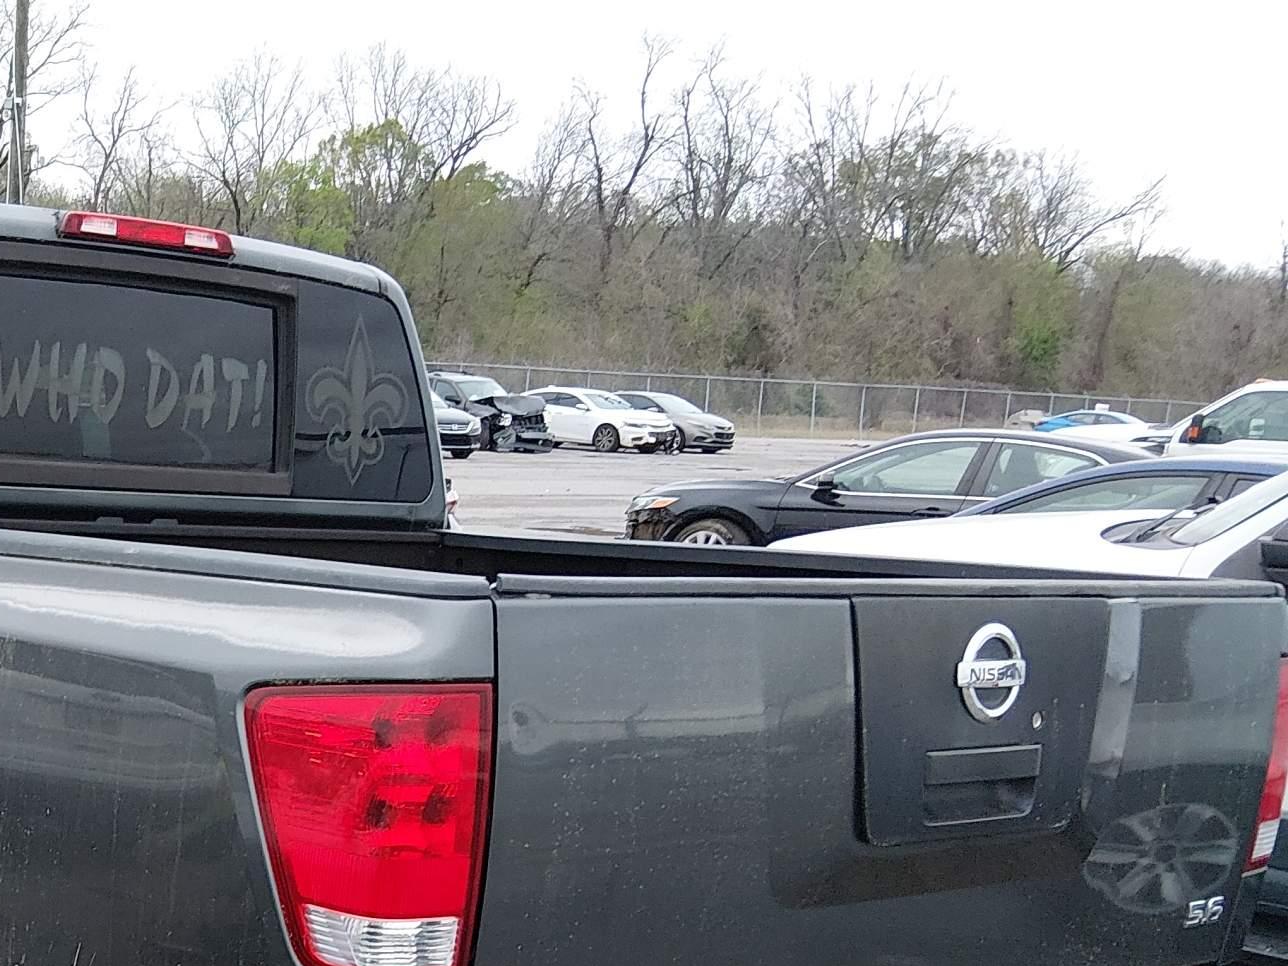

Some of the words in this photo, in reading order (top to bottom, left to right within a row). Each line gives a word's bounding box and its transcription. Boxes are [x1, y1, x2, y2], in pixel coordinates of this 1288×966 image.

[144, 346, 268, 433] DAT!
[969, 662, 1023, 682] NISSAN
[1183, 895, 1225, 928] 5.6
